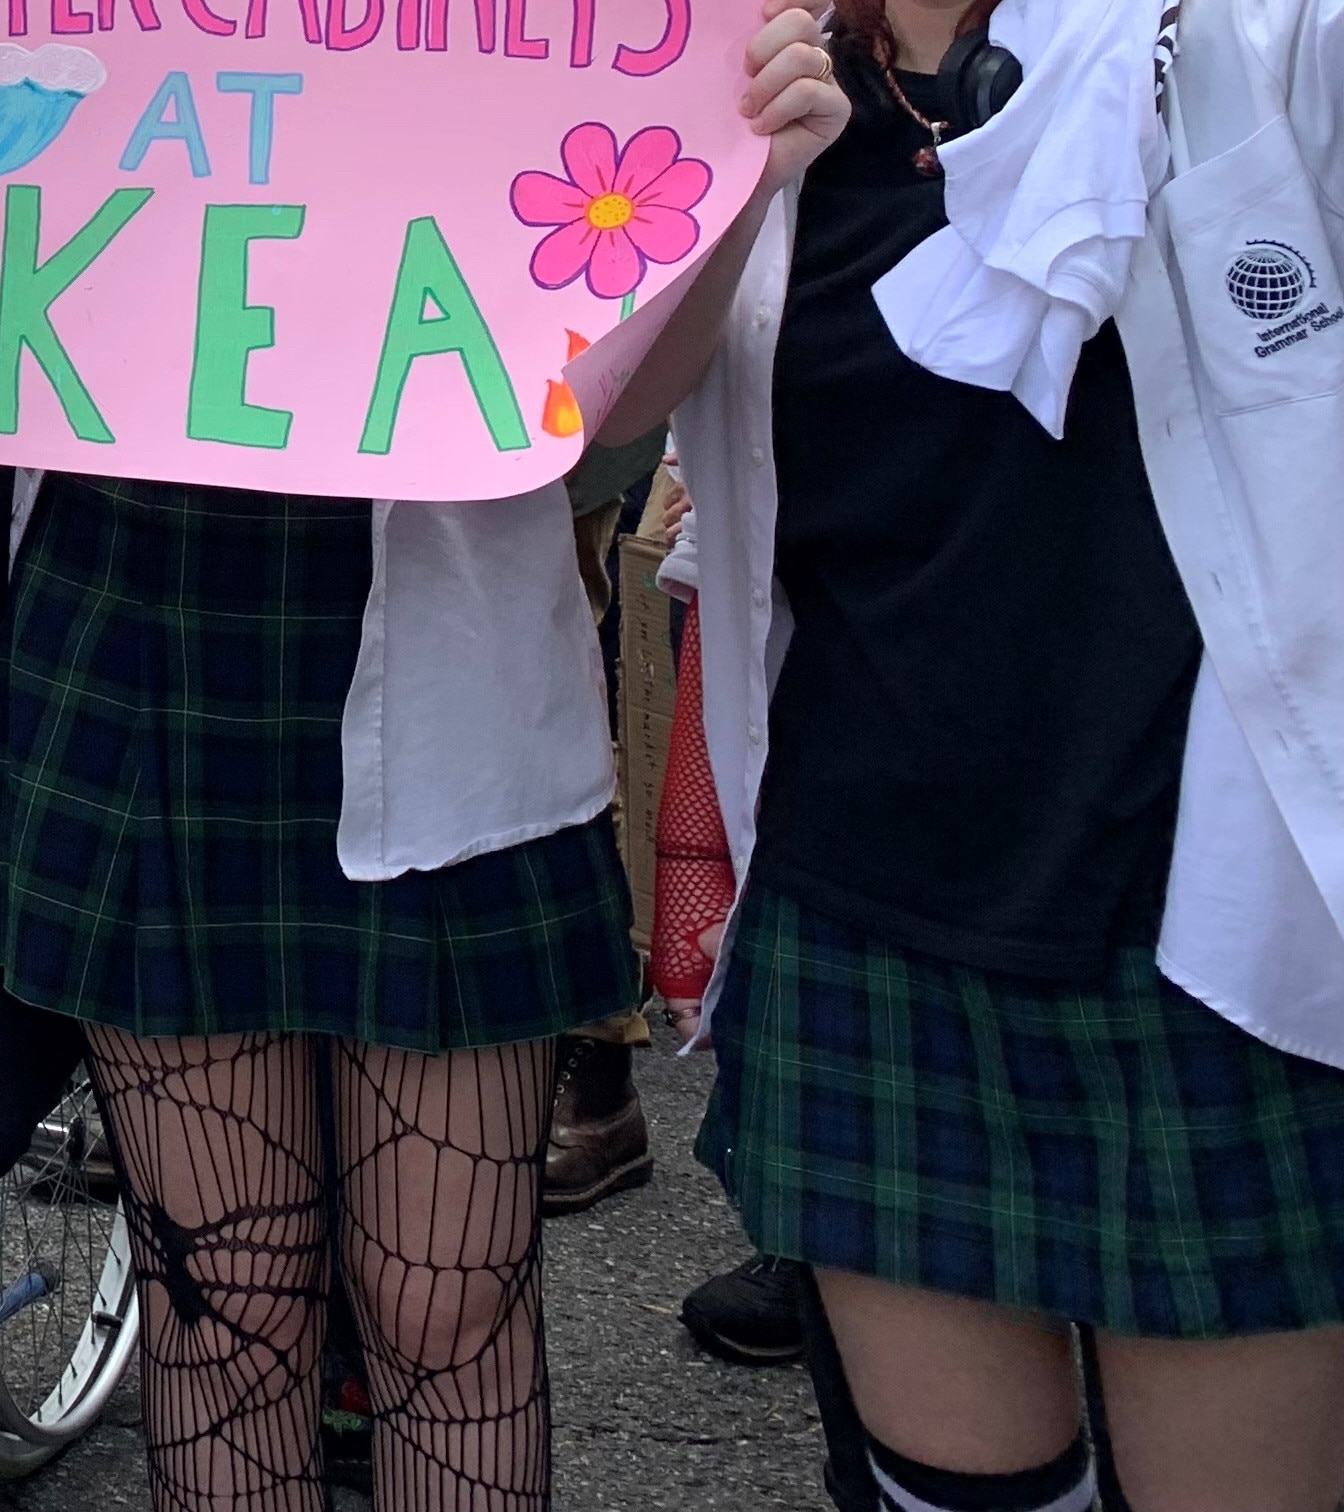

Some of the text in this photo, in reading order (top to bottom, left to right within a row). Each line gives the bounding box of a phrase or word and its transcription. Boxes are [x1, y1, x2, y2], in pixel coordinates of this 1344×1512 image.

[118, 71, 304, 186] AT
[1256, 302, 1330, 342] International
[1254, 328, 1309, 358] Grammar
